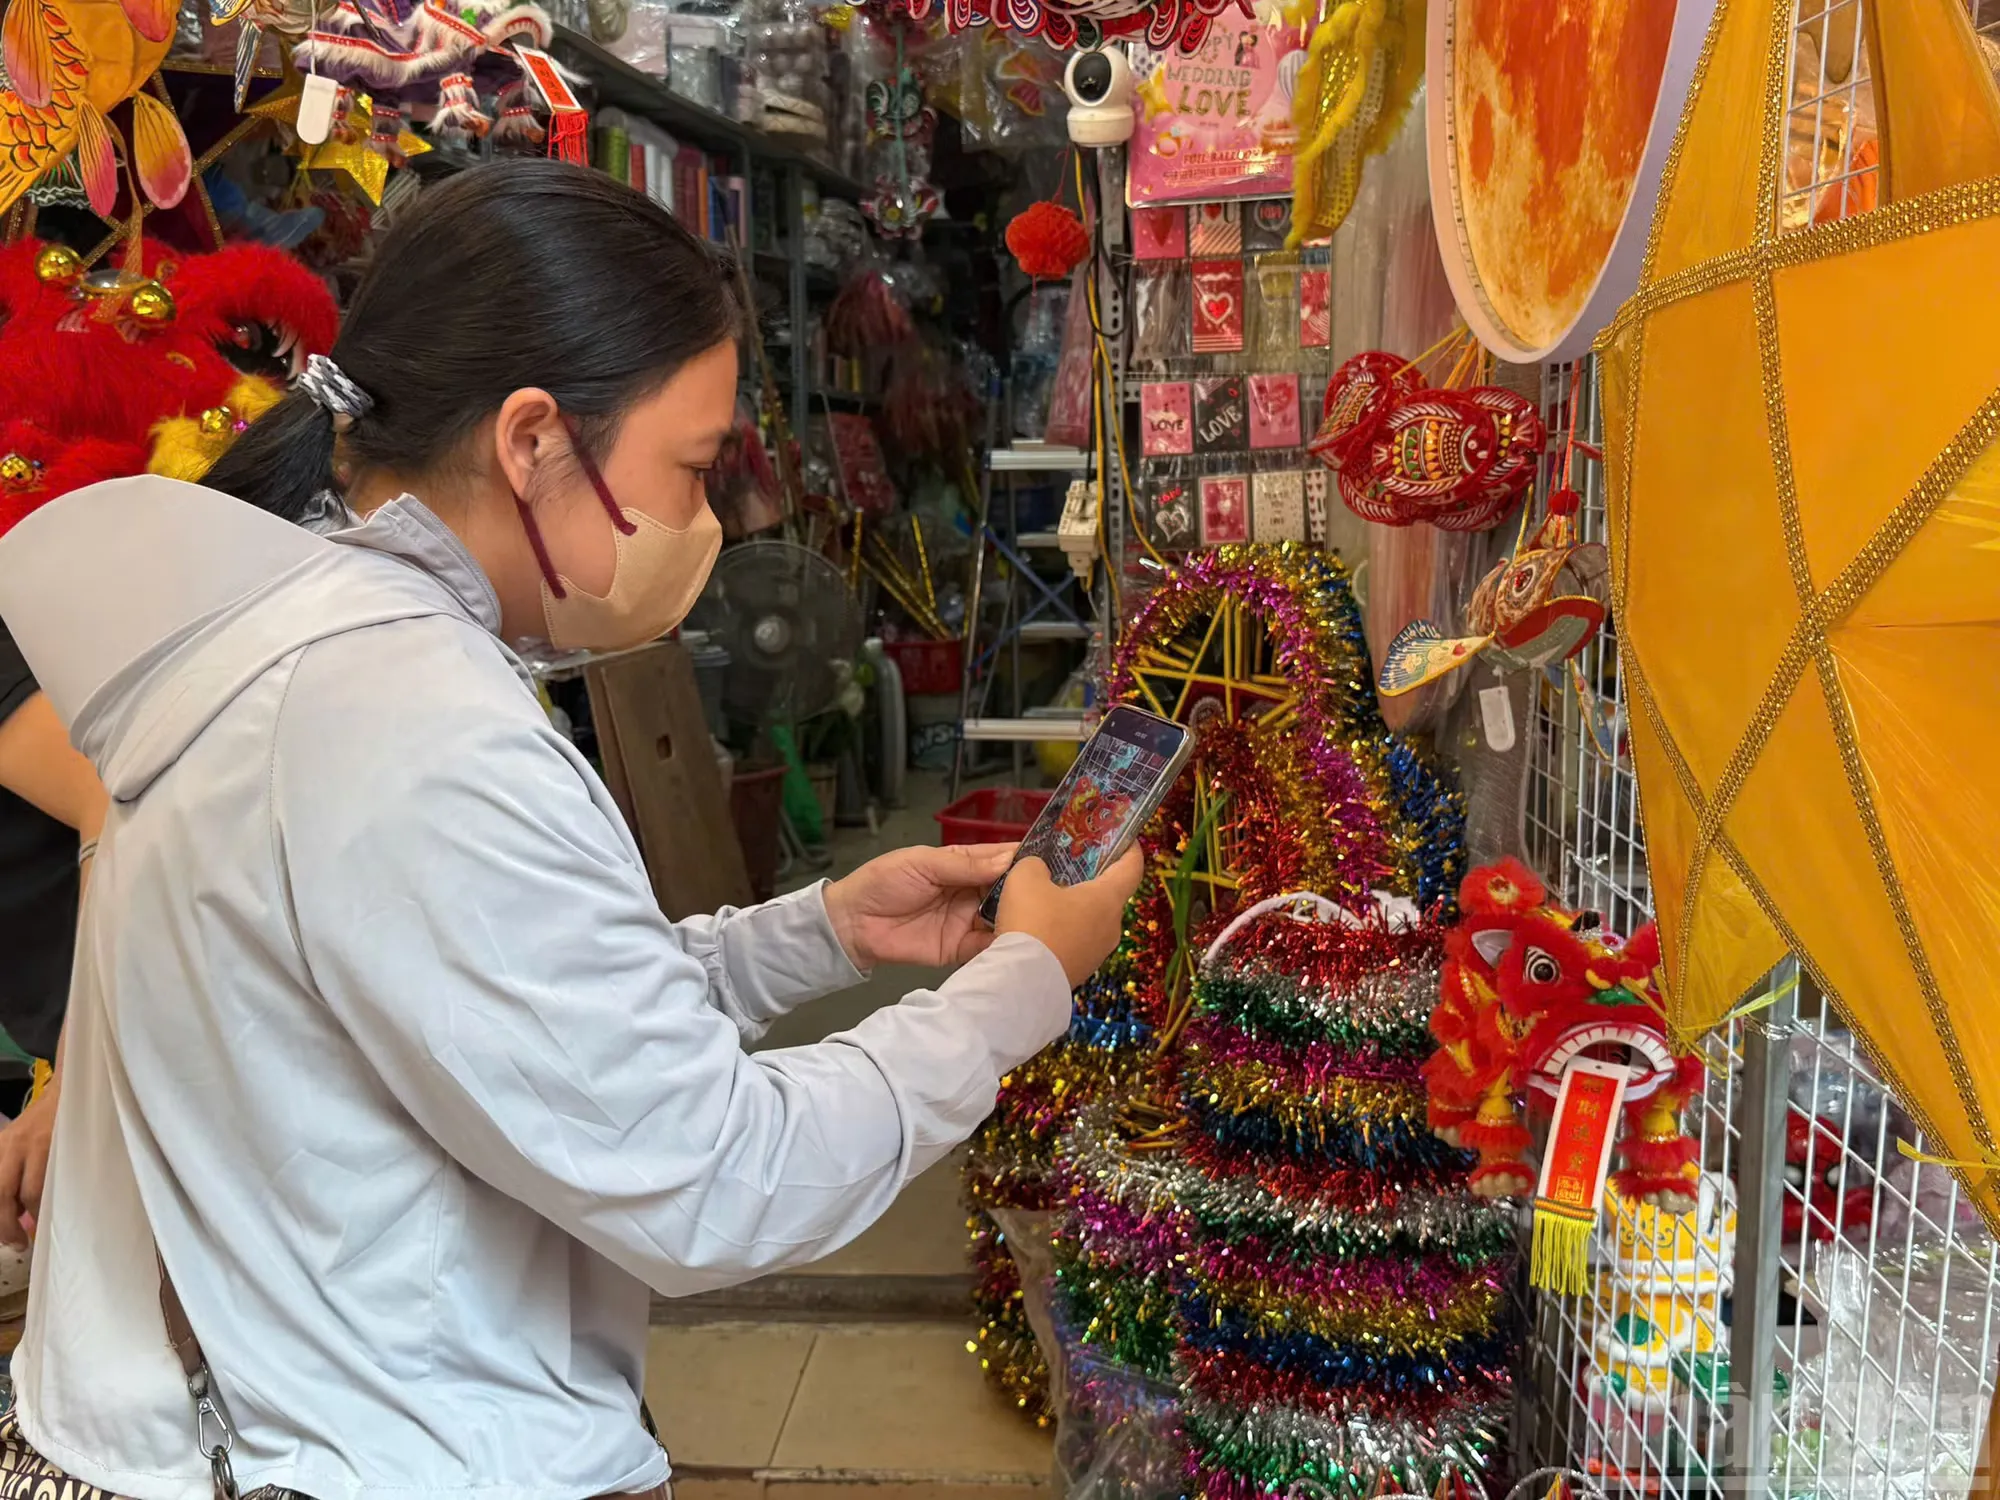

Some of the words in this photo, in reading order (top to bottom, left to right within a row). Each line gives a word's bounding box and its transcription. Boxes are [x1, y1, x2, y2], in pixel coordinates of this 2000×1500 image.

[1168, 66, 1252, 87] WEDDING
[1179, 85, 1252, 118] LOVE
[1151, 419, 1184, 431] LOVE
[1200, 404, 1243, 444] LOVE
